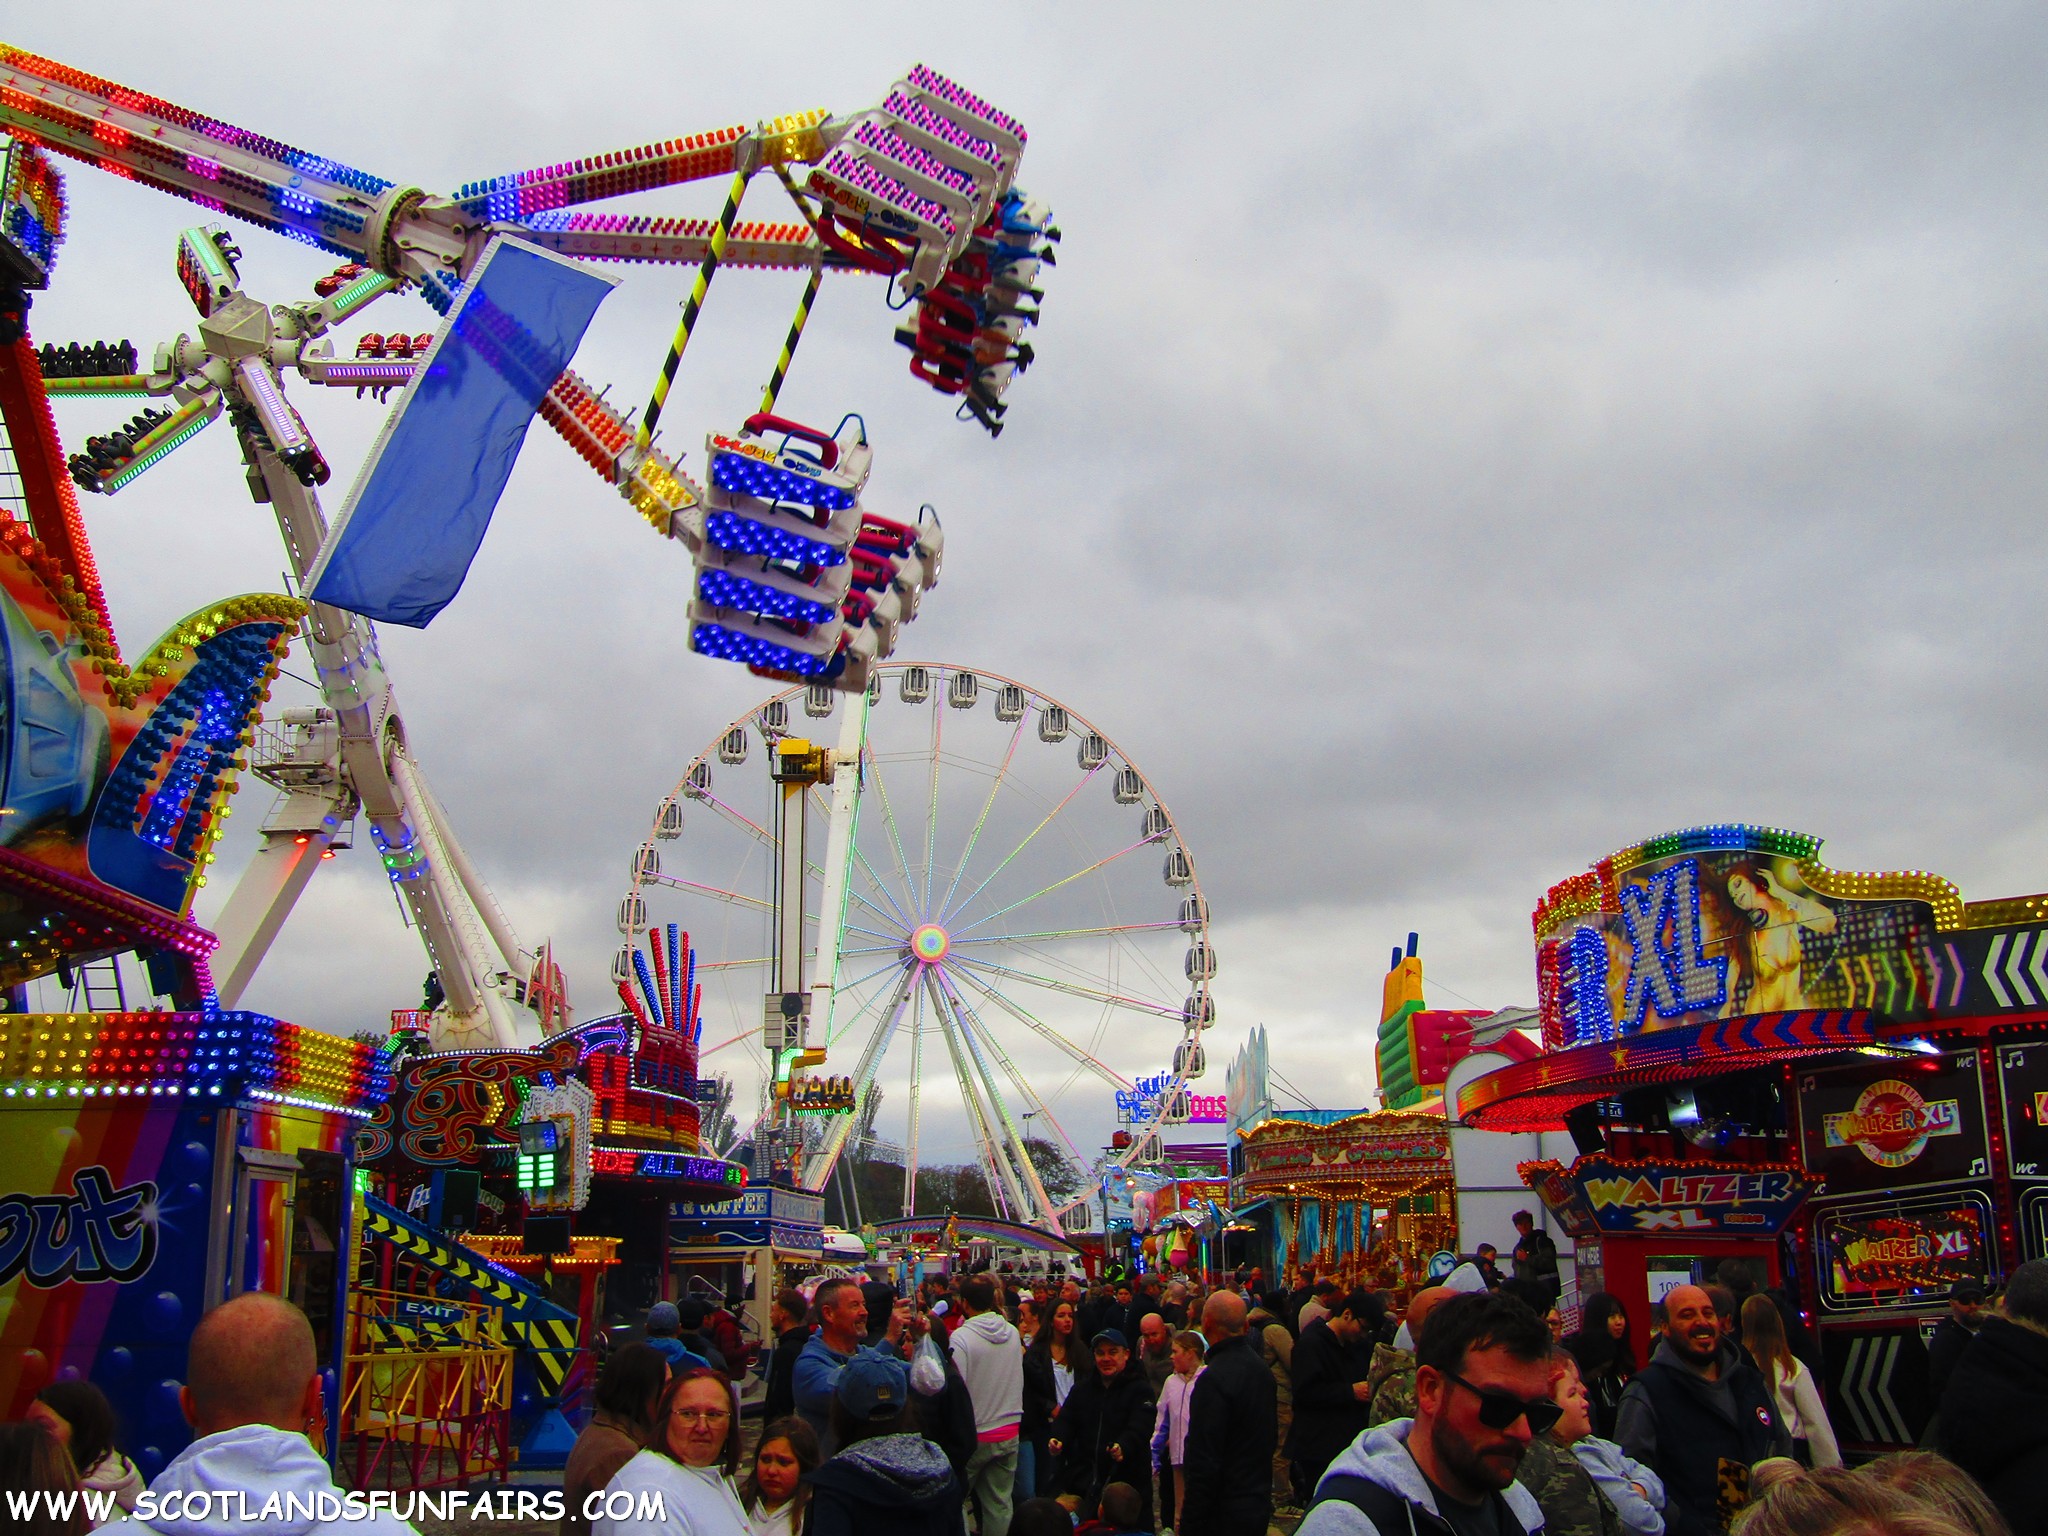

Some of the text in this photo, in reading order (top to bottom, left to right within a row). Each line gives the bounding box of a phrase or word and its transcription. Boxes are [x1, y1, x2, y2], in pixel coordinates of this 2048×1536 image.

[1618, 858, 1728, 1034] XL
[1834, 1104, 1953, 1139] WALTZER XL
[642, 1153, 682, 1175] ALL
[2015, 1162, 2038, 1175] WC
[1584, 1171, 1794, 1211] WALTZER
[1631, 1209, 1718, 1231] XL
[1844, 1230, 1971, 1266] WALTZER XL
[406, 1302, 455, 1318] EXIT
